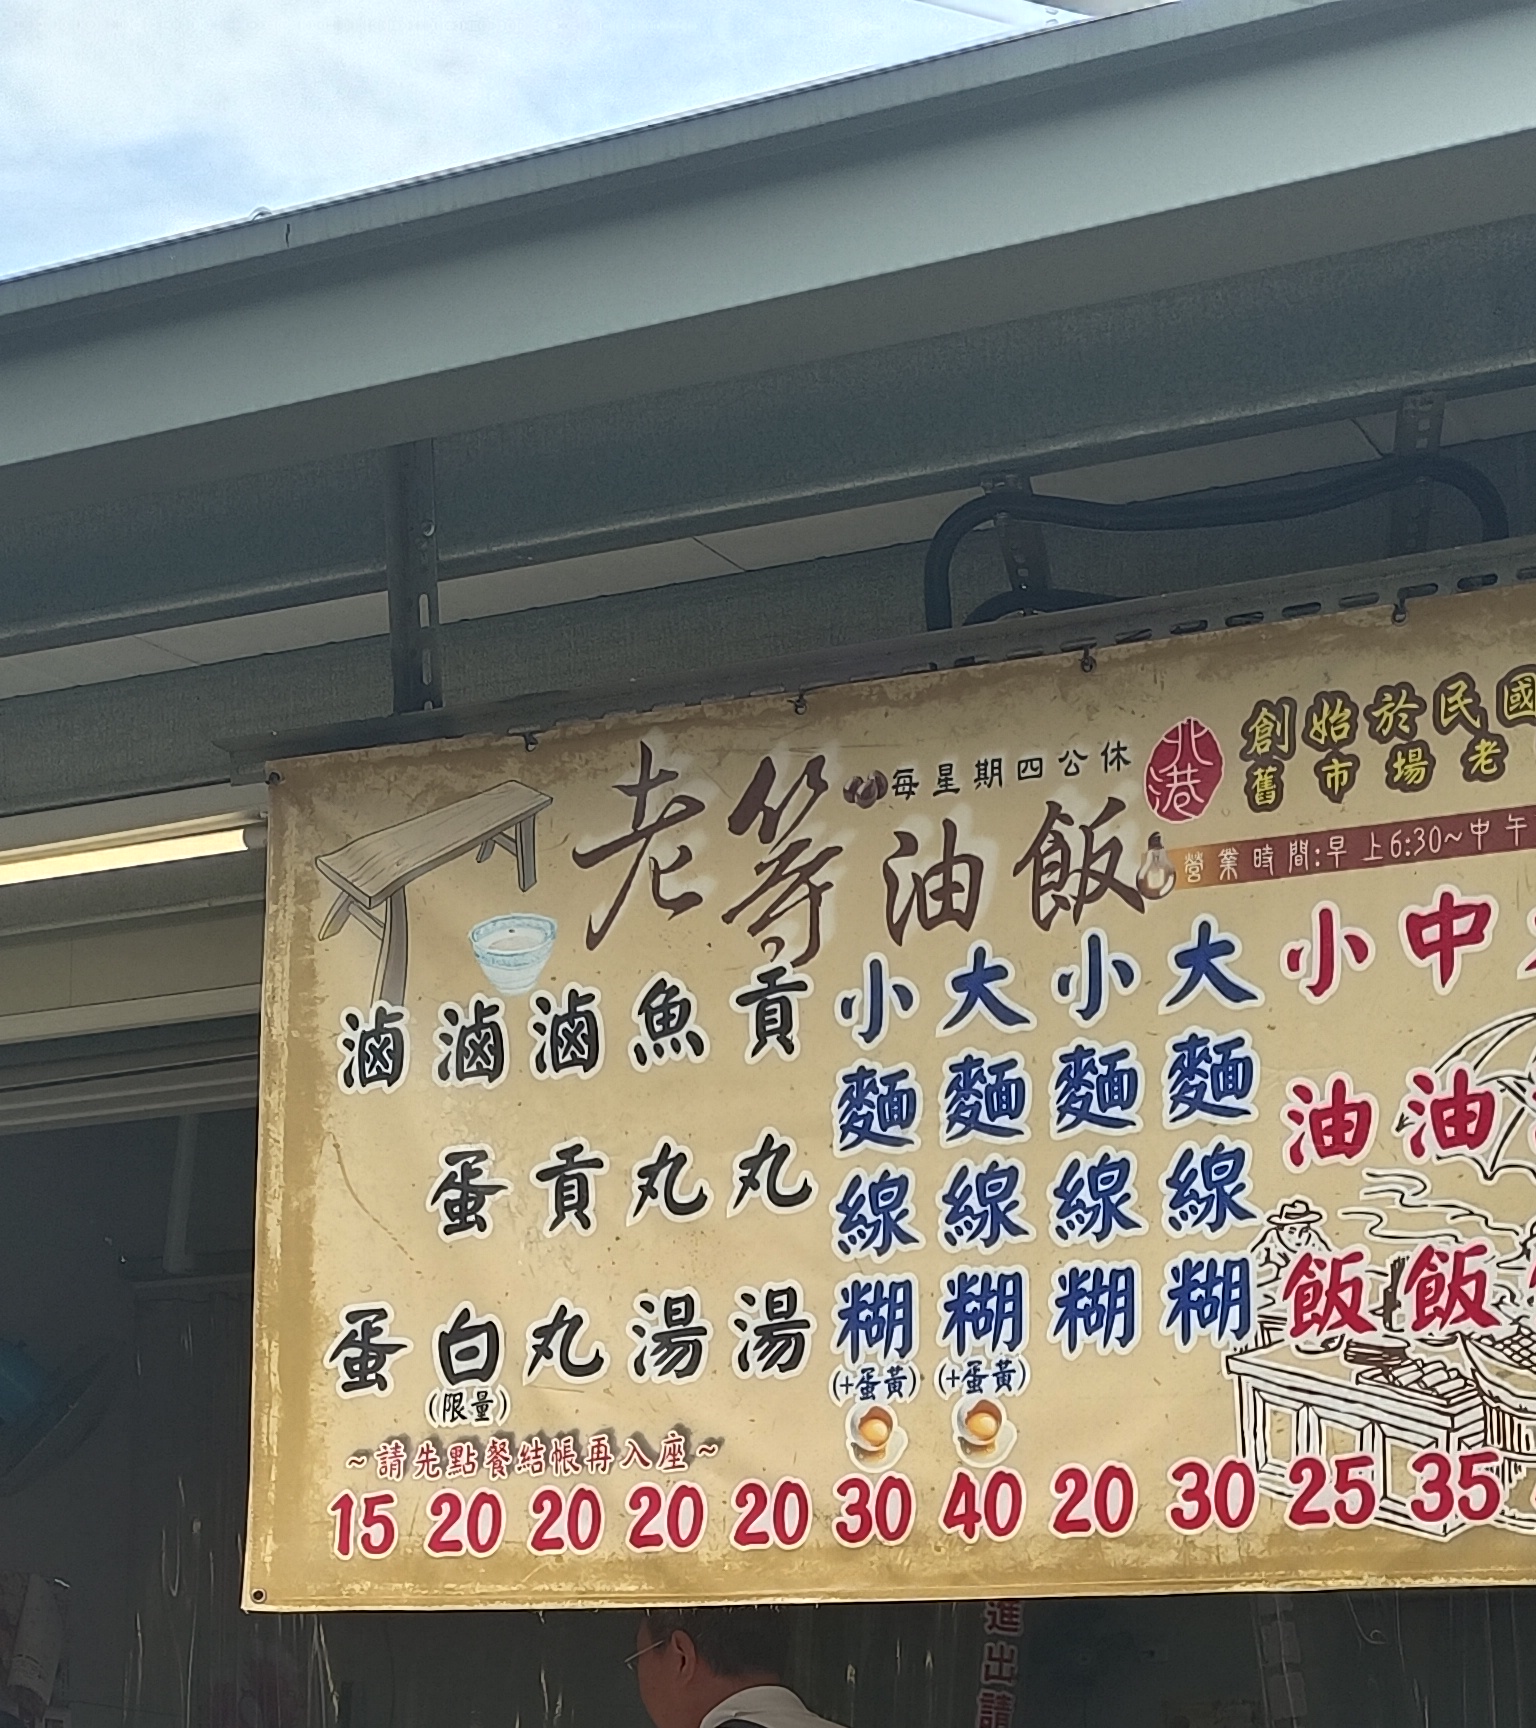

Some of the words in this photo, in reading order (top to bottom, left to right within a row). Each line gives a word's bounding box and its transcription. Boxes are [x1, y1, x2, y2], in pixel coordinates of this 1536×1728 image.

[890, 740, 1132, 801] 每星期四公休
[1147, 718, 1221, 821] 北港
[832, 1361, 918, 1404] (+蛋黃)
[937, 1356, 1028, 1400] (+蛋黃)
[428, 1390, 508, 1425] (限量)
[331, 1493, 395, 1557] 15
[428, 1489, 503, 1554] 20
[530, 1487, 602, 1551] 20
[629, 1484, 703, 1549] 20
[732, 1480, 808, 1546] 20
[835, 1475, 913, 1543] 30
[942, 1471, 1022, 1541] 40
[1053, 1466, 1135, 1537] 20
[1170, 1460, 1255, 1532] 30
[1288, 1456, 1376, 1526] 25
[1412, 1451, 1501, 1523] 35
